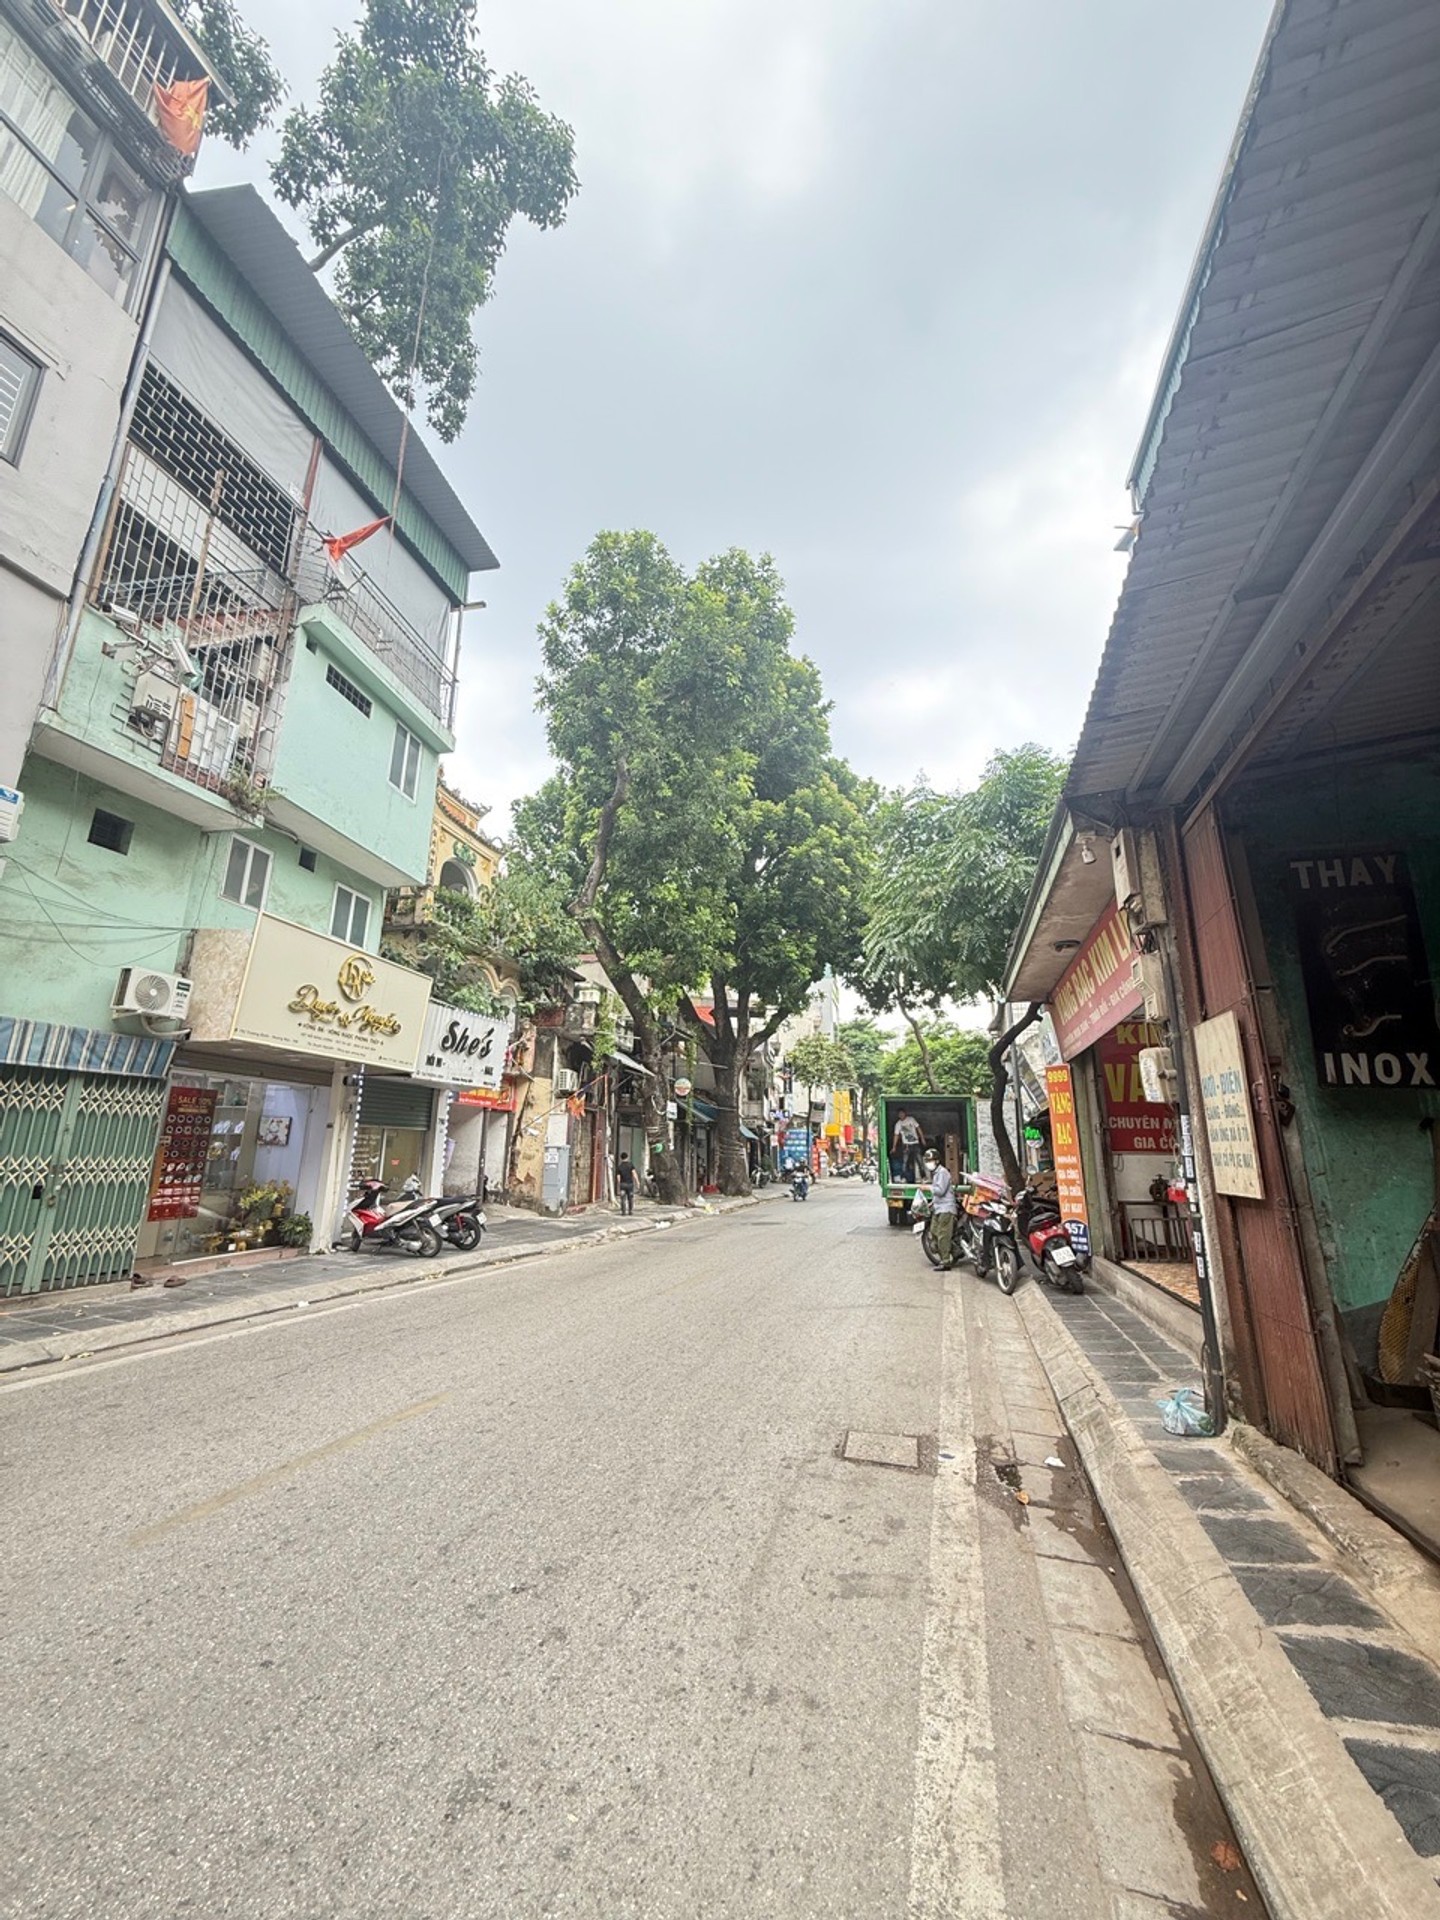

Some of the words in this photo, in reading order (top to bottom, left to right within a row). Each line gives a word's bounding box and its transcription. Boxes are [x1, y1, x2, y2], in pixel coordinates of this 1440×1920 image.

[1290, 855, 1397, 889] THAY
[1087, 929, 1119, 986] KIM
[441, 1020, 495, 1060] She's
[1047, 1070, 1068, 1083] 9999
[1324, 1053, 1437, 1085] INOX
[1050, 1086, 1073, 1114] VÀNG
[1056, 1122, 1073, 1150] BẠC
[1108, 1115, 1160, 1129] CHUYÊN
[1134, 1137, 1157, 1149] GIA
